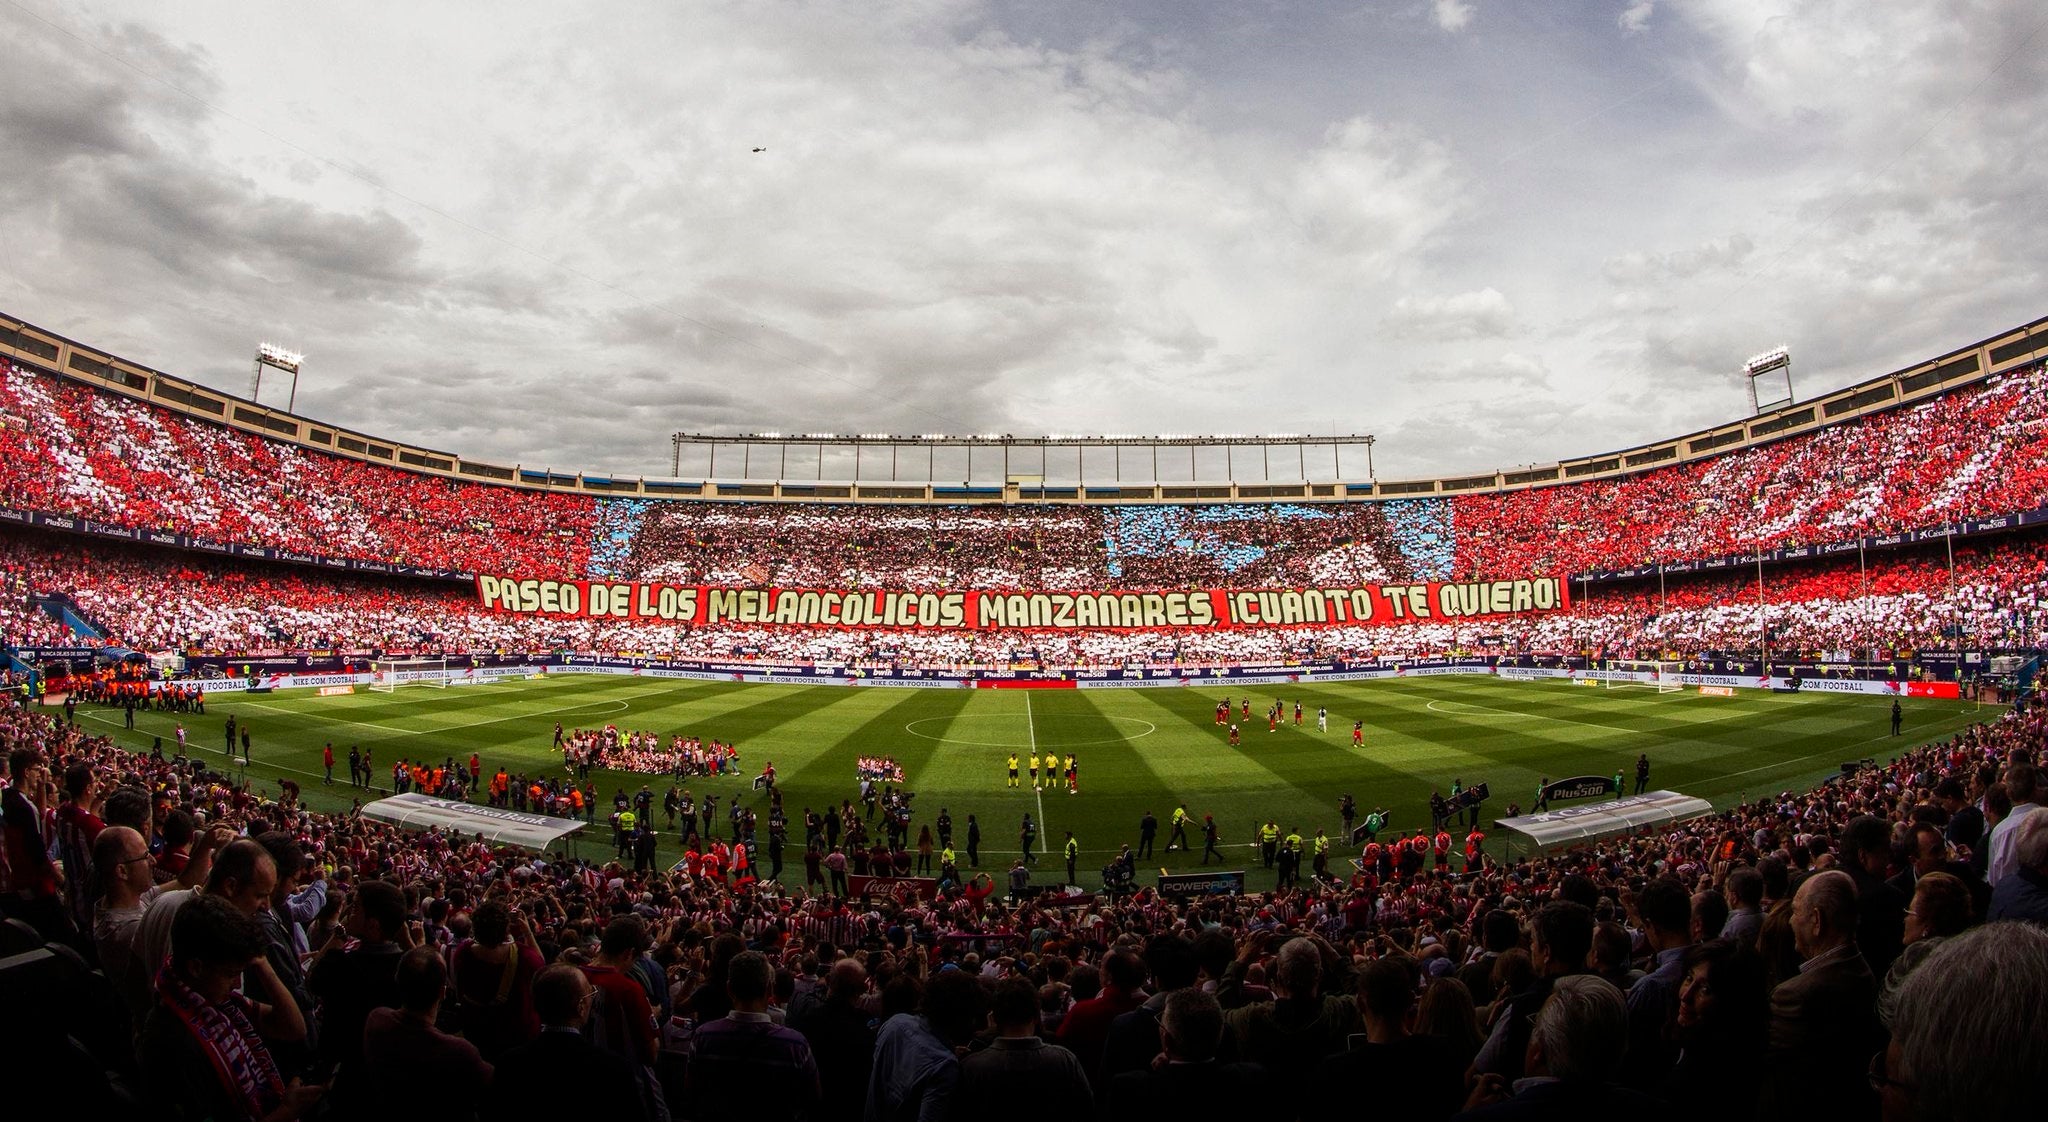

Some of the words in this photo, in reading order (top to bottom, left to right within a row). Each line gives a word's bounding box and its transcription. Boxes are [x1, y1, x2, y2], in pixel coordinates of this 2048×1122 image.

[46, 518, 74, 530] Plus500
[1978, 520, 2007, 531] Plus500
[103, 524, 133, 538] CaixaBank
[150, 534, 176, 545] Plus500
[1876, 536, 1901, 546] Plus500
[242, 548, 266, 558] Plus500
[1786, 549, 1808, 559] Plus500
[479, 574, 580, 614] PASEO
[589, 584, 631, 617] DE
[638, 586, 697, 620] LOS
[1382, 585, 1430, 618] TE
[1439, 578, 1562, 617] QUIERO!
[815, 667, 835, 675] bwin
[902, 669, 922, 677] bwin
[1152, 669, 1172, 677] bwin
[1181, 668, 1201, 676] bwin
[1573, 678, 1598, 687] bet365
[1553, 784, 1604, 800] Plus500
[1560, 796, 1656, 818] CaixaBank
[451, 804, 546, 826] CaixaBank
[1163, 879, 1238, 892] POWERADE
